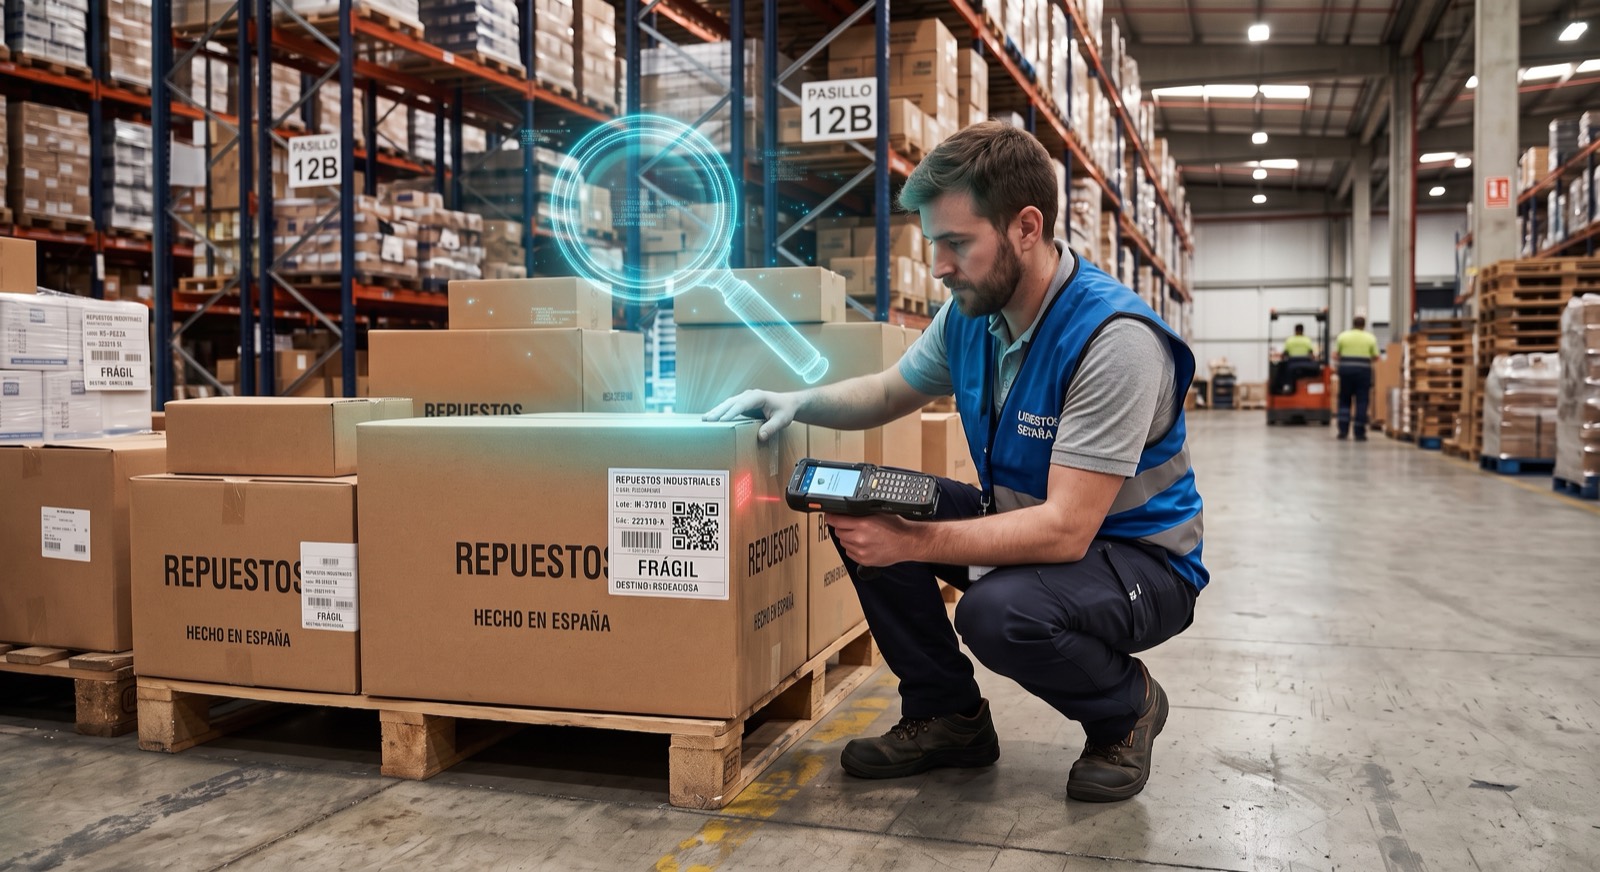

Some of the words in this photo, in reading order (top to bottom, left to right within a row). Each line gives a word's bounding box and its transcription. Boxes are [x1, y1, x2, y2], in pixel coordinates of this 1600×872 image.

[808, 84, 872, 100] PASILLO
[809, 105, 872, 135] 12B
[292, 138, 338, 152] PASILLO
[295, 156, 338, 181] 12B
[100, 365, 134, 378] FRÁGIL
[615, 475, 661, 485] REPUESTOS
[663, 476, 721, 486] INDUSTRIALES
[456, 541, 608, 580] REPUESTO
[748, 523, 799, 577] REPUESTOS
[638, 556, 698, 578] FRÁGIL
[317, 610, 343, 621] FRÁGIL
[474, 608, 523, 628] HECHO
[528, 611, 546, 629] EN
[552, 609, 611, 632] ESPAÑA
[753, 606, 771, 632] HECHO
[770, 604, 777, 621] EN
[186, 625, 224, 642] HECHO
[227, 628, 242, 643] EN
[246, 628, 291, 647] ESPAÑA
